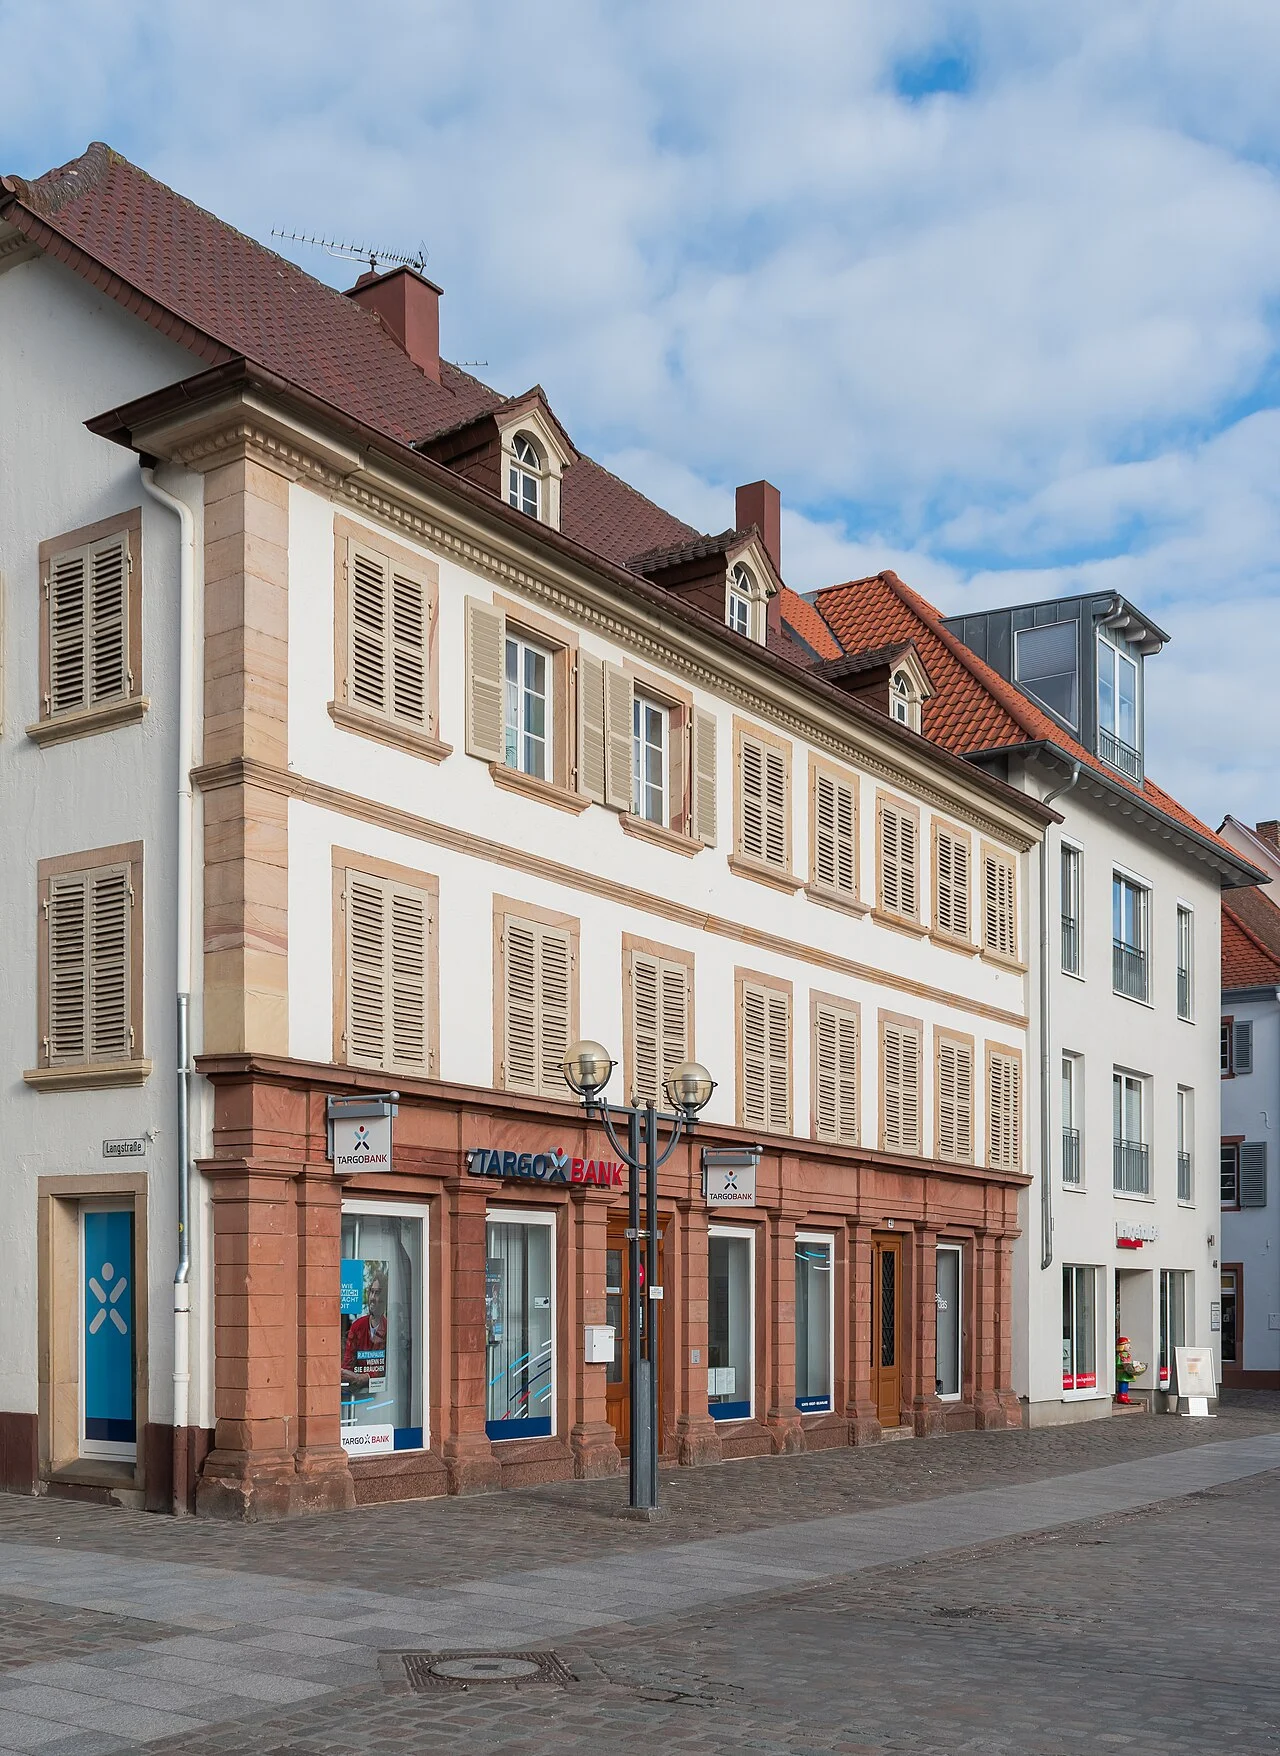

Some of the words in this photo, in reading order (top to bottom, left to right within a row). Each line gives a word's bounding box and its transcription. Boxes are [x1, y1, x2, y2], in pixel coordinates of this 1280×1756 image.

[106, 1141, 142, 1155] Langstraße
[337, 1154, 388, 1164] TARGOBANK
[477, 1148, 547, 1179] TARGO
[571, 1157, 625, 1186] BANK
[342, 1436, 365, 1446] TARGO
[371, 1435, 390, 1444] BANK
